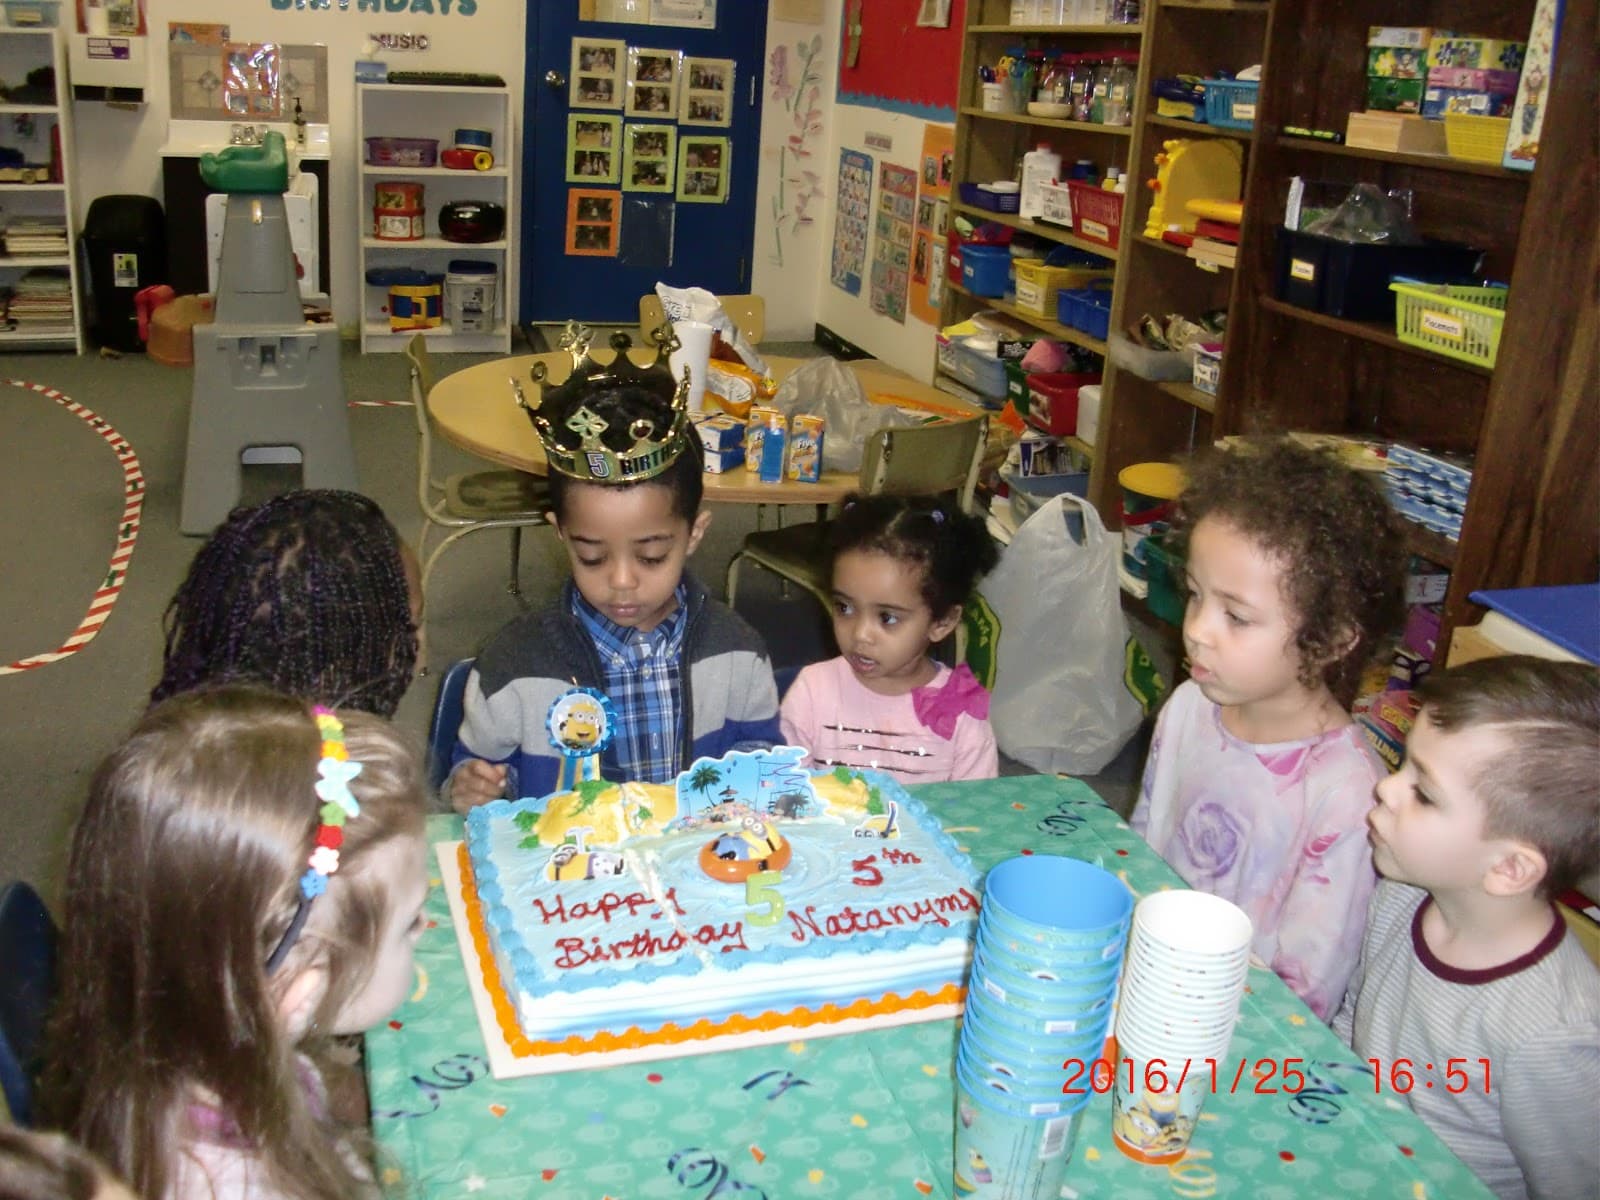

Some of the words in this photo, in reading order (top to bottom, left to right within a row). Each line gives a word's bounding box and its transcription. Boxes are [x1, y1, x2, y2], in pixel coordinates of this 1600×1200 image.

[370, 33, 429, 50] MUSIC
[585, 452, 610, 478] 5
[532, 887, 687, 925] Happy
[745, 872, 785, 927] 5
[554, 921, 749, 969] Birthday
